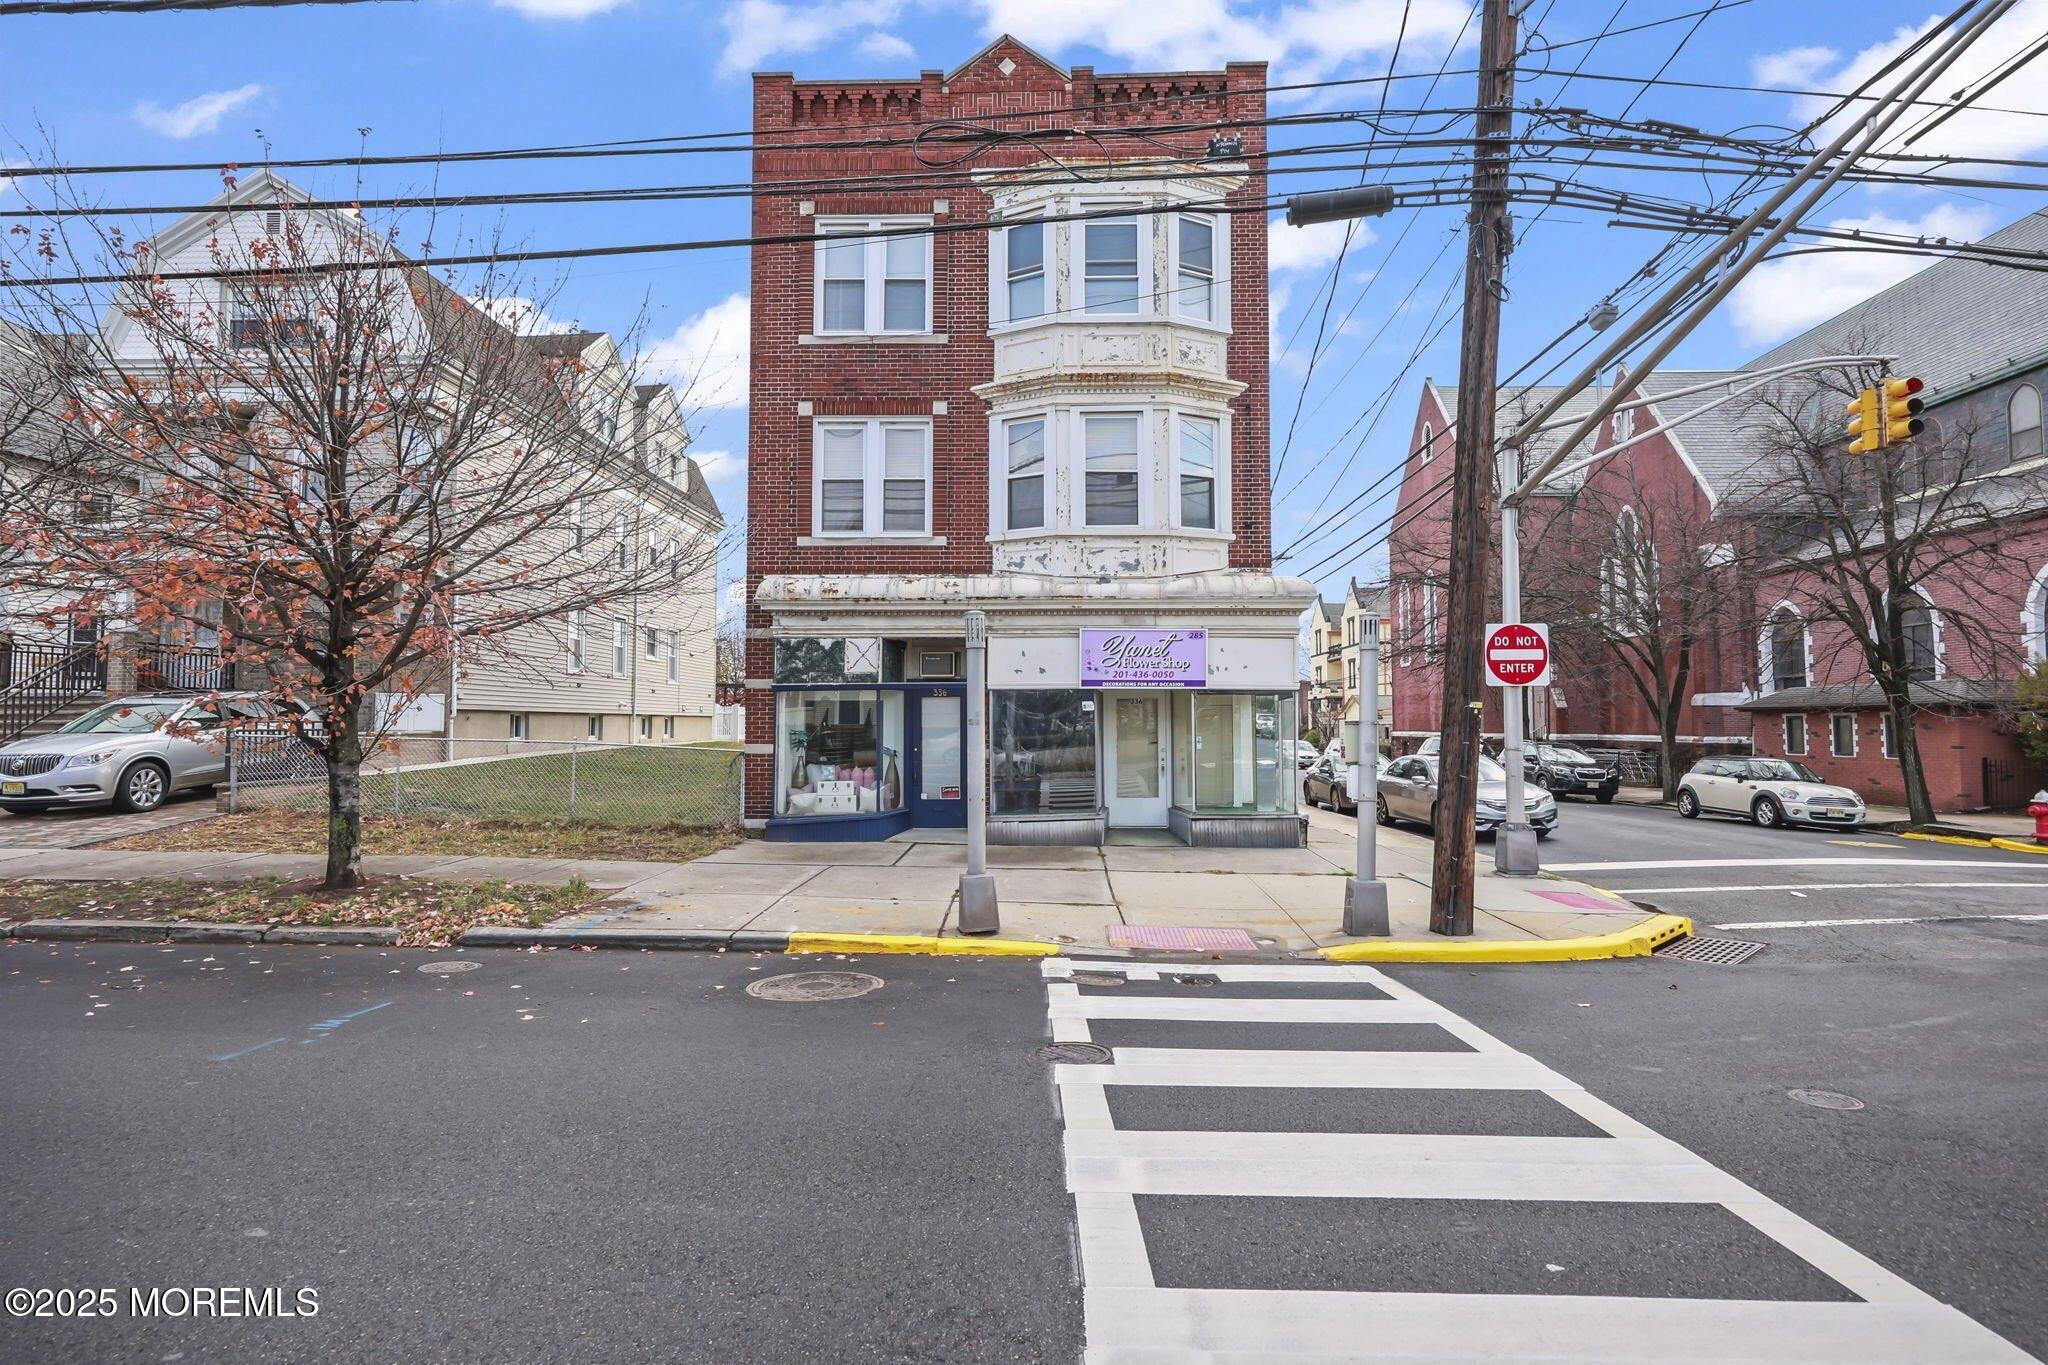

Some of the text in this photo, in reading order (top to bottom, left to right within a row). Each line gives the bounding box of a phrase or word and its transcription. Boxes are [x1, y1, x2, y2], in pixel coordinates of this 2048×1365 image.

[1494, 636, 1538, 646] DO NOT
[1101, 633, 1183, 668] Yanet
[1122, 656, 1191, 672] Flower Shop
[1500, 663, 1535, 673] ENTER
[1112, 670, 1175, 679] 201-436-0050
